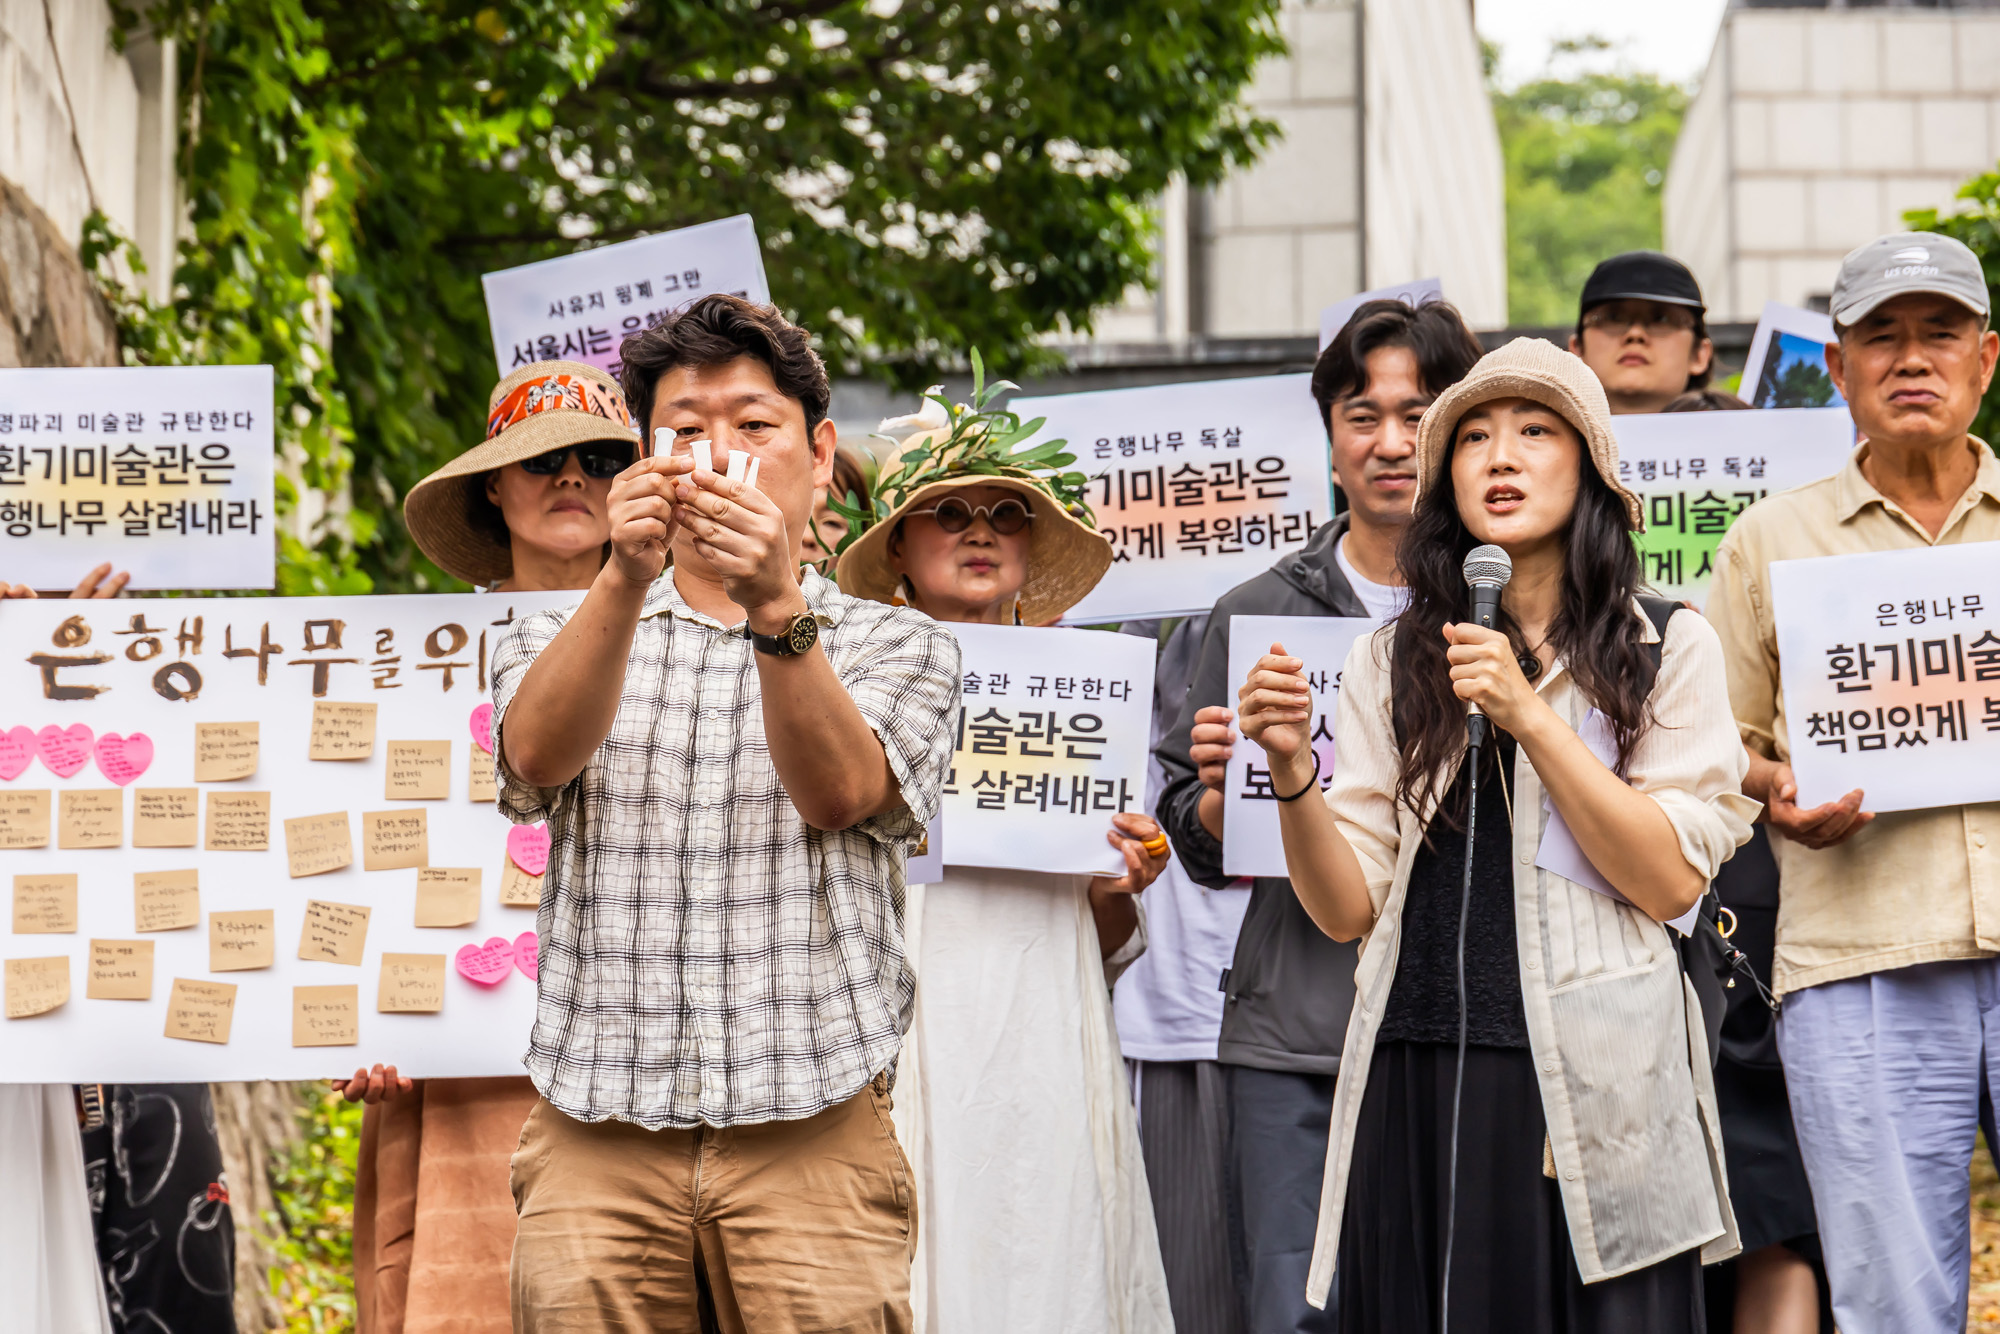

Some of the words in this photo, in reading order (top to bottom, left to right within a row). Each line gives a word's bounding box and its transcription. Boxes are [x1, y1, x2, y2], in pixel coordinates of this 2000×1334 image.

[1901, 264, 1940, 277] open
[549, 290, 606, 319] 사유지
[665, 268, 702, 293] 그만
[78, 412, 145, 433] 미술관
[161, 410, 254, 432] 규탄한다
[1094, 431, 1185, 460] 은행나무
[1200, 426, 1243, 449] 독살
[0, 443, 236, 486] 환기미술관은
[1080, 455, 1291, 511] 기미술관은
[1723, 456, 1768, 479] 독살
[118, 499, 263, 537] 살려내라
[1176, 511, 1318, 557] 복원하라
[1876, 595, 1984, 627] 은행나무
[24, 613, 403, 703] 은행나무를
[416, 606, 516, 695] 위
[1826, 630, 2000, 693] 환기미술
[1026, 676, 1133, 702] 규탄한다
[956, 706, 1107, 760] 술관은
[1806, 699, 1968, 753] 책임있게
[971, 769, 1134, 813] 살려내라
